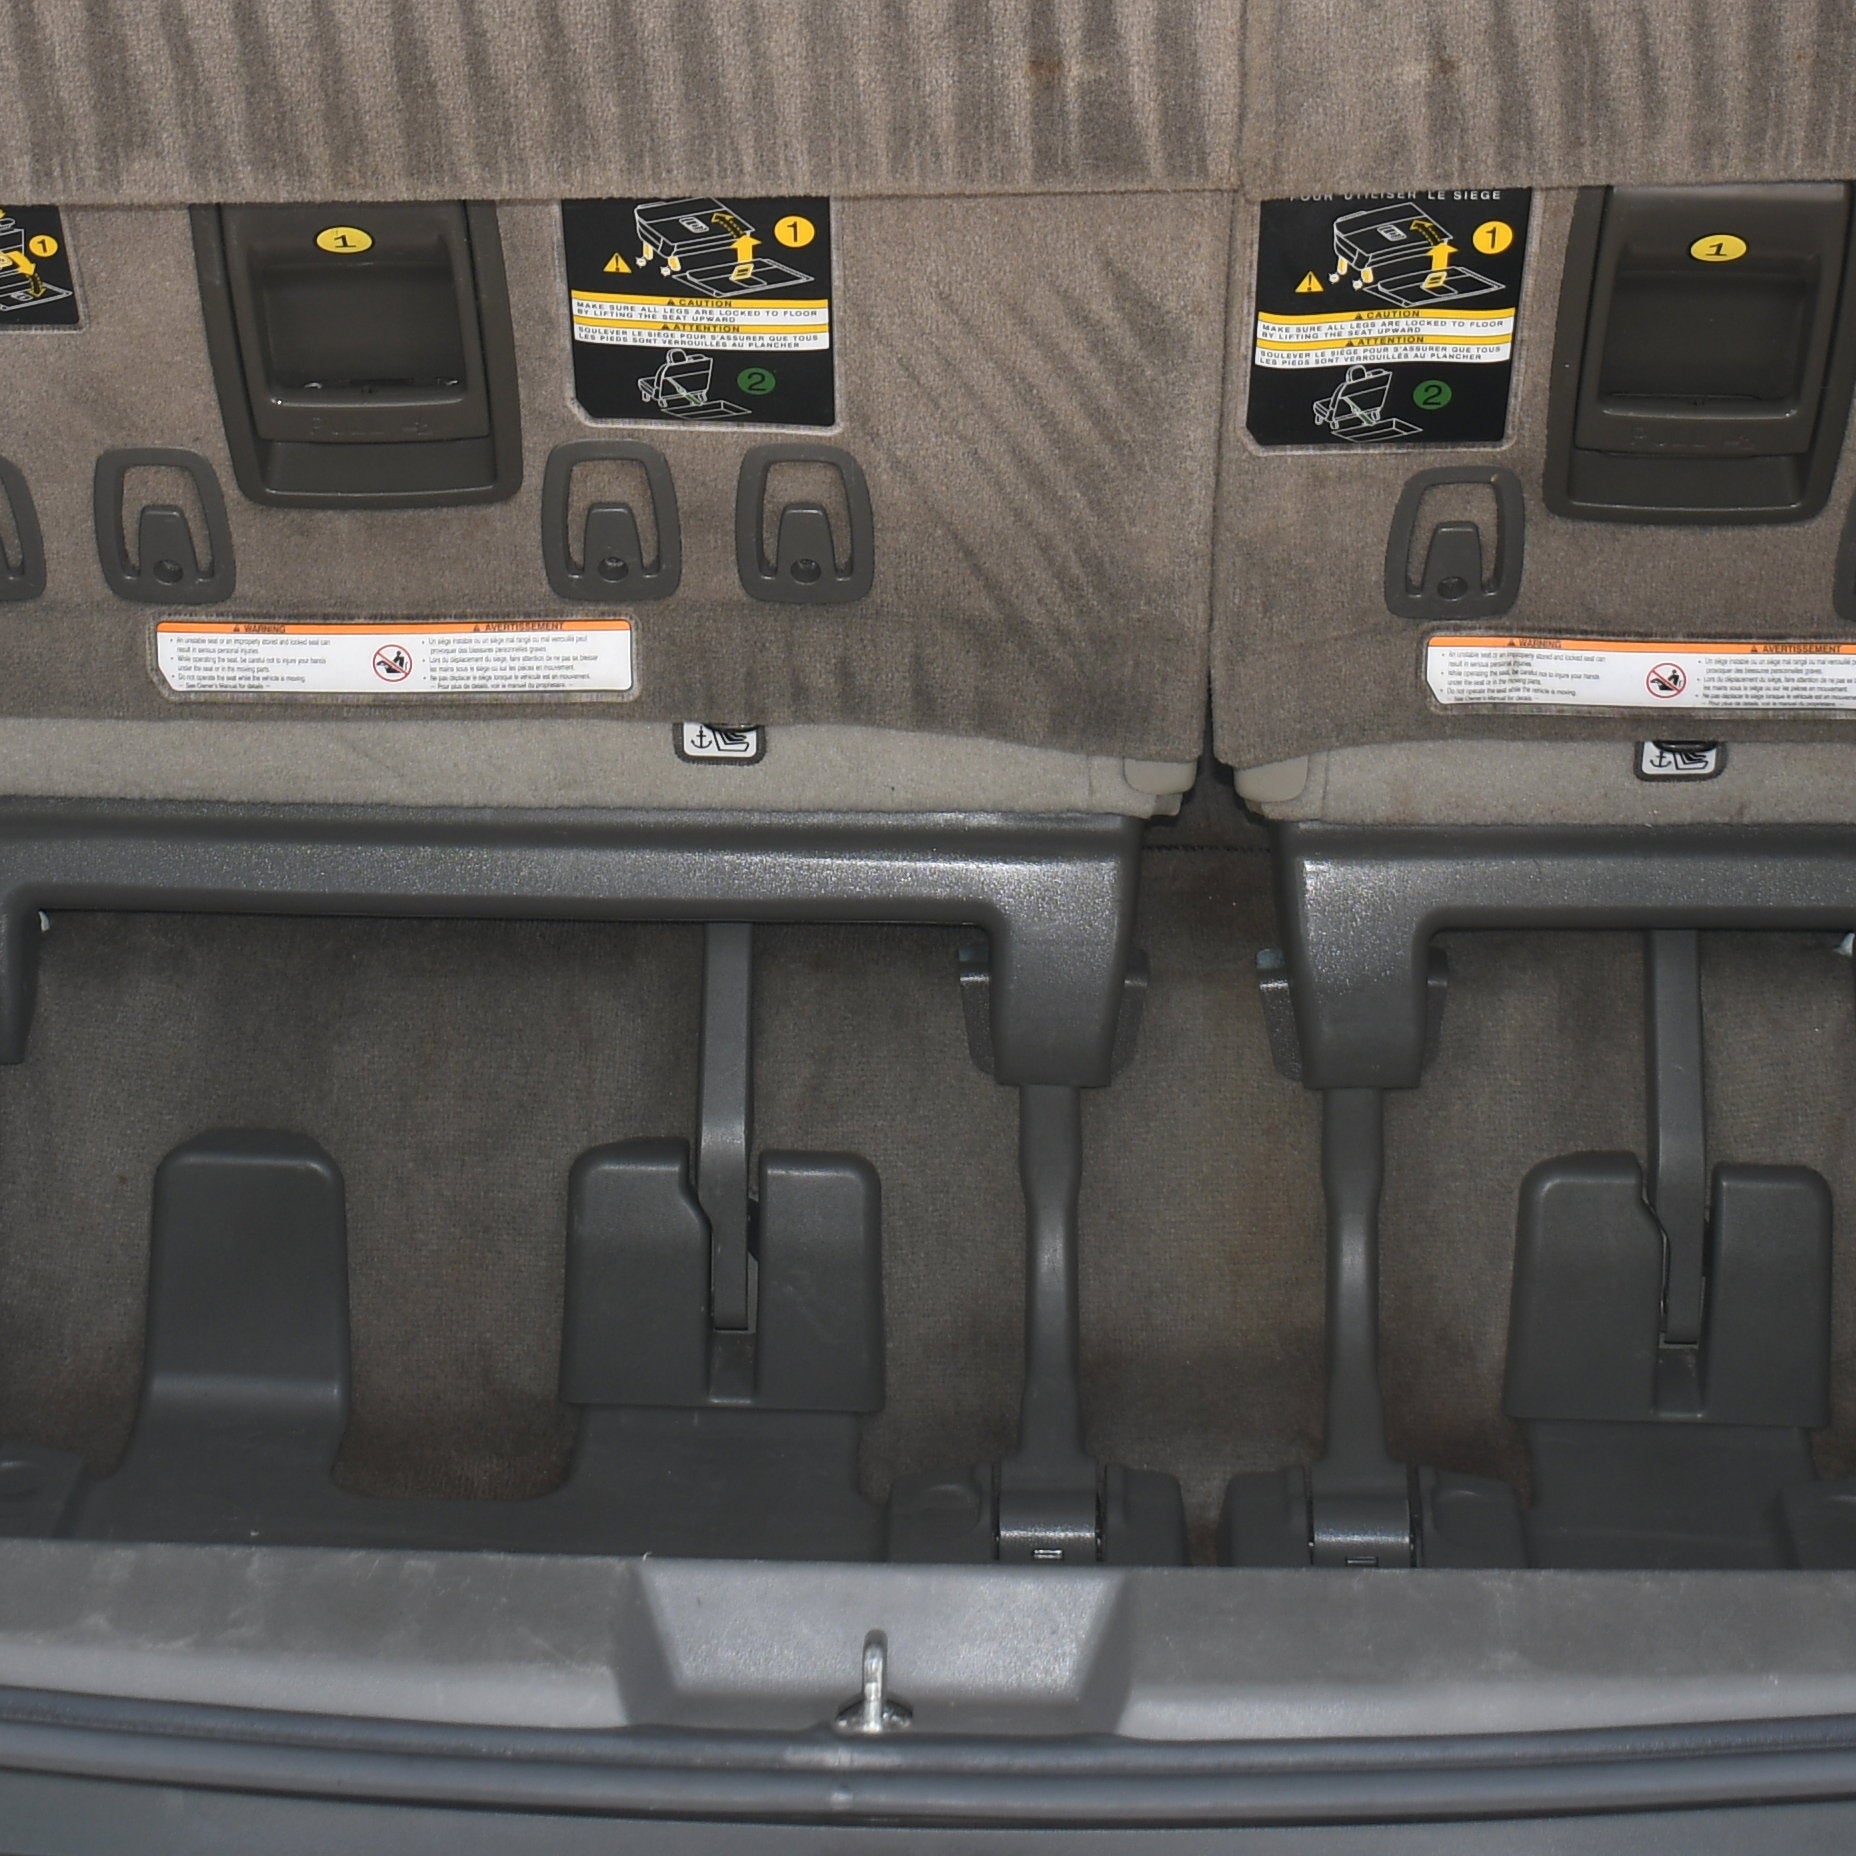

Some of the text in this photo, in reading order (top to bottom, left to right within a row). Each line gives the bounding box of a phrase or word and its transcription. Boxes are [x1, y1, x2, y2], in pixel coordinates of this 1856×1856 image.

[1427, 190, 1446, 200] LE
[786, 221, 798, 243] 1
[1486, 226, 1498, 249] 1
[37, 238, 48, 254] 1
[334, 234, 357, 248] 1
[1705, 242, 1728, 257] 1
[576, 301, 605, 310] MAKE
[609, 304, 635, 312] SURE
[719, 309, 761, 317] LOCKED
[679, 298, 732, 307] CAUTION
[594, 309, 633, 318] LIFTING
[638, 312, 657, 320] THE
[692, 315, 736, 323] UPWARD
[1366, 310, 1420, 319] CAUTION
[578, 326, 628, 336] SOULEVER
[673, 324, 740, 333] ATTENTION
[1262, 323, 1291, 333] MAKE
[1295, 325, 1322, 333] SURE
[1349, 321, 1376, 329] LEGS
[1405, 319, 1447, 327] LOCKED
[1469, 320, 1504, 328] FLOOR
[600, 334, 628, 343] PIEDS
[1278, 332, 1319, 340] LIFTING
[1347, 329, 1373, 337] SEAT
[1377, 327, 1422, 335] UPWARD
[1357, 336, 1425, 346] ATTENTION
[1260, 350, 1311, 359] SOULEVER
[1315, 350, 1326, 358] LE
[1362, 346, 1389, 354] POUR
[1260, 358, 1278, 366] LES
[1314, 357, 1340, 365] SONT
[747, 372, 767, 391] 2
[1422, 384, 1442, 406] 2
[244, 624, 286, 633] WARNING
[485, 622, 564, 631] AVERTISSEMENT
[1762, 644, 1841, 653] AVERTISSEMENT
